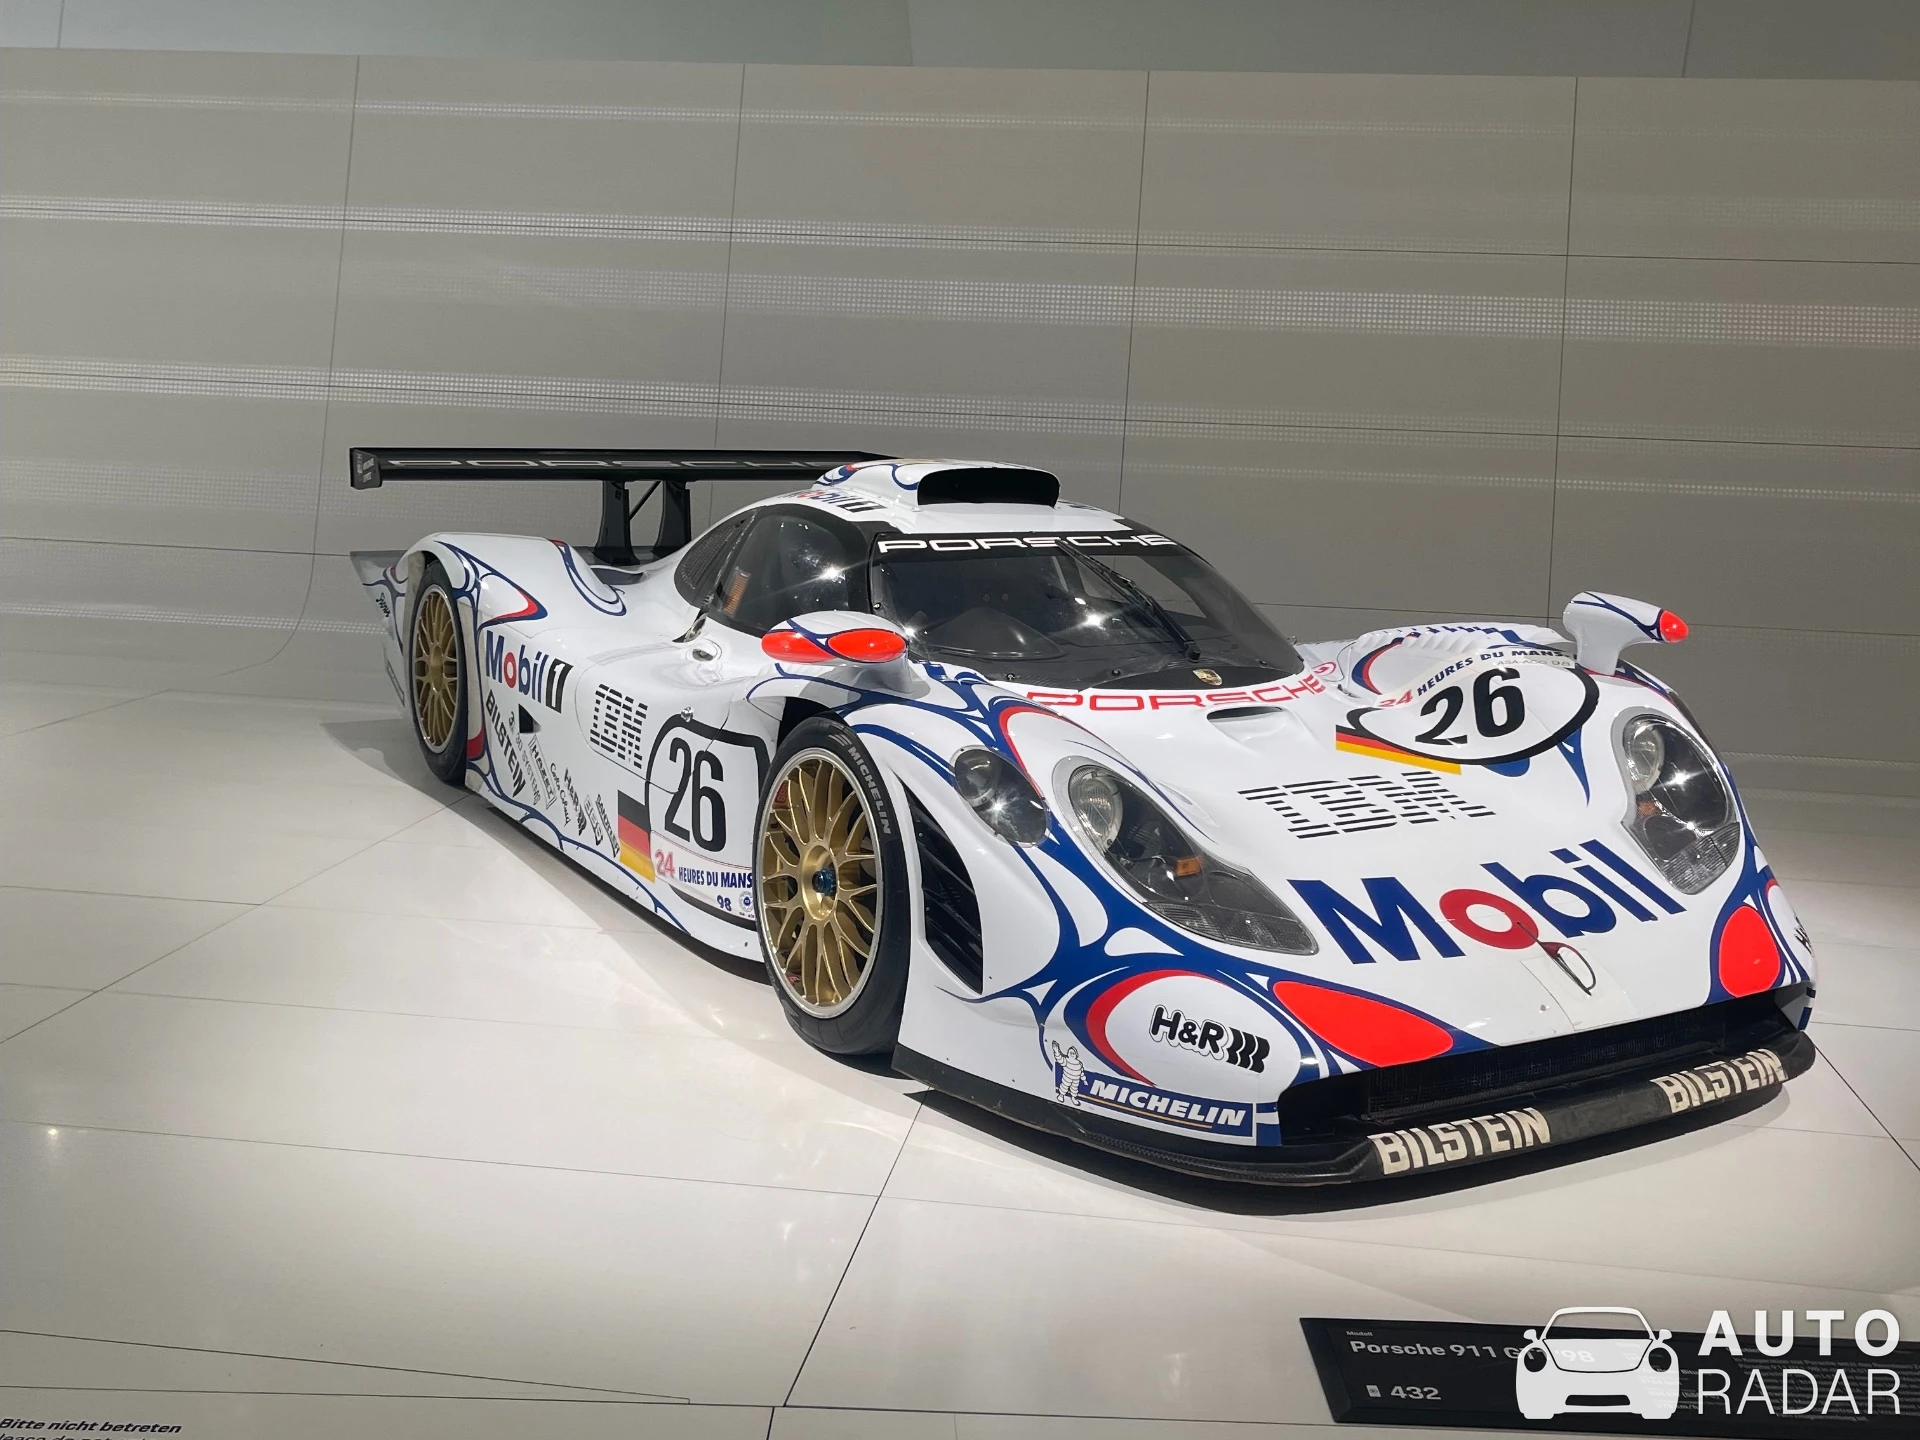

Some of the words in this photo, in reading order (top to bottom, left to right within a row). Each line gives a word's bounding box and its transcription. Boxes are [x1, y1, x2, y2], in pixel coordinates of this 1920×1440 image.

[877, 534, 1178, 554] PORSCHE
[485, 630, 549, 703] Mobil
[1027, 674, 1326, 711] PORSCHE
[1377, 689, 1414, 707] 24
[1416, 657, 1474, 696] HEURES
[1480, 651, 1504, 661] DU
[590, 683, 648, 769] IBM
[1415, 667, 1525, 745] 26
[485, 689, 526, 798] BILSTEIN
[664, 737, 726, 852] 26
[847, 746, 891, 835] MICHELIN
[1237, 771, 1496, 839] IBM
[655, 849, 675, 878] 24
[678, 867, 704, 886] HEURES
[706, 870, 719, 887] DU
[721, 872, 752, 888] MANS
[717, 895, 732, 912] 98
[1286, 839, 1687, 965] Mobil
[1150, 1006, 1226, 1055] H&R
[1089, 1080, 1247, 1127] MICHELIN
[1649, 1048, 1789, 1114] BILSTEIN
[1367, 1107, 1551, 1176] BILSTEIN
[1350, 1341, 1446, 1356] Porsche
[1450, 1345, 1497, 1358] 911
[1390, 1385, 1442, 1400] 432
[0, 1418, 46, 1430] Bitte
[47, 1420, 99, 1431] nicht
[99, 1421, 183, 1434] betreten
